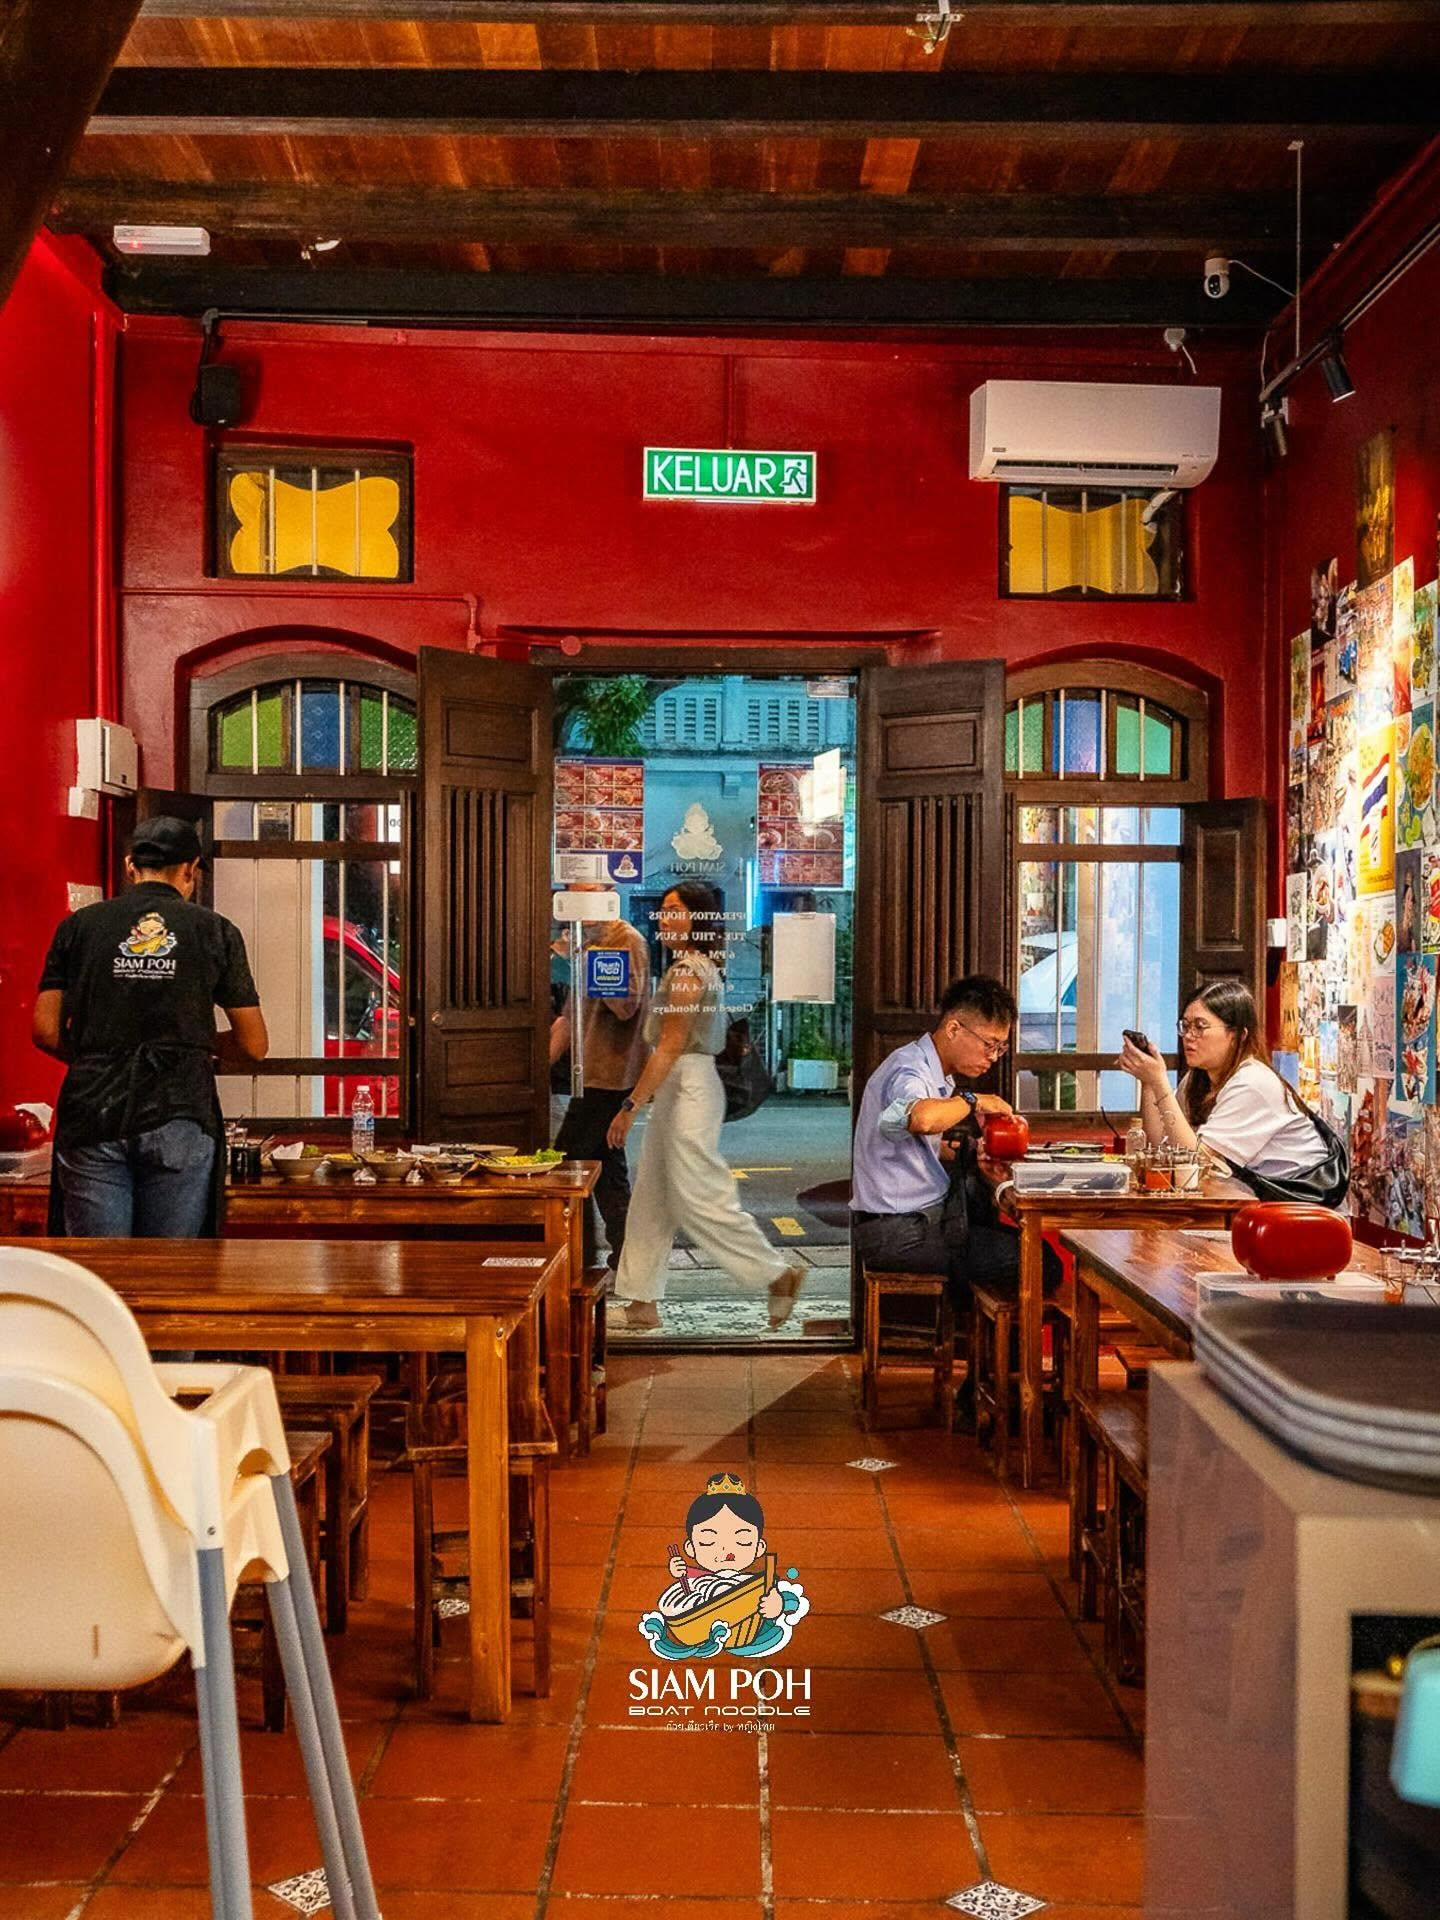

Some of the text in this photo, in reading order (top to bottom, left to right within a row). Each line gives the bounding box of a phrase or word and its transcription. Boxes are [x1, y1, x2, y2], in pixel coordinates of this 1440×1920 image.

[653, 454, 777, 494] KELUAR
[113, 957, 176, 970] SIAM POH
